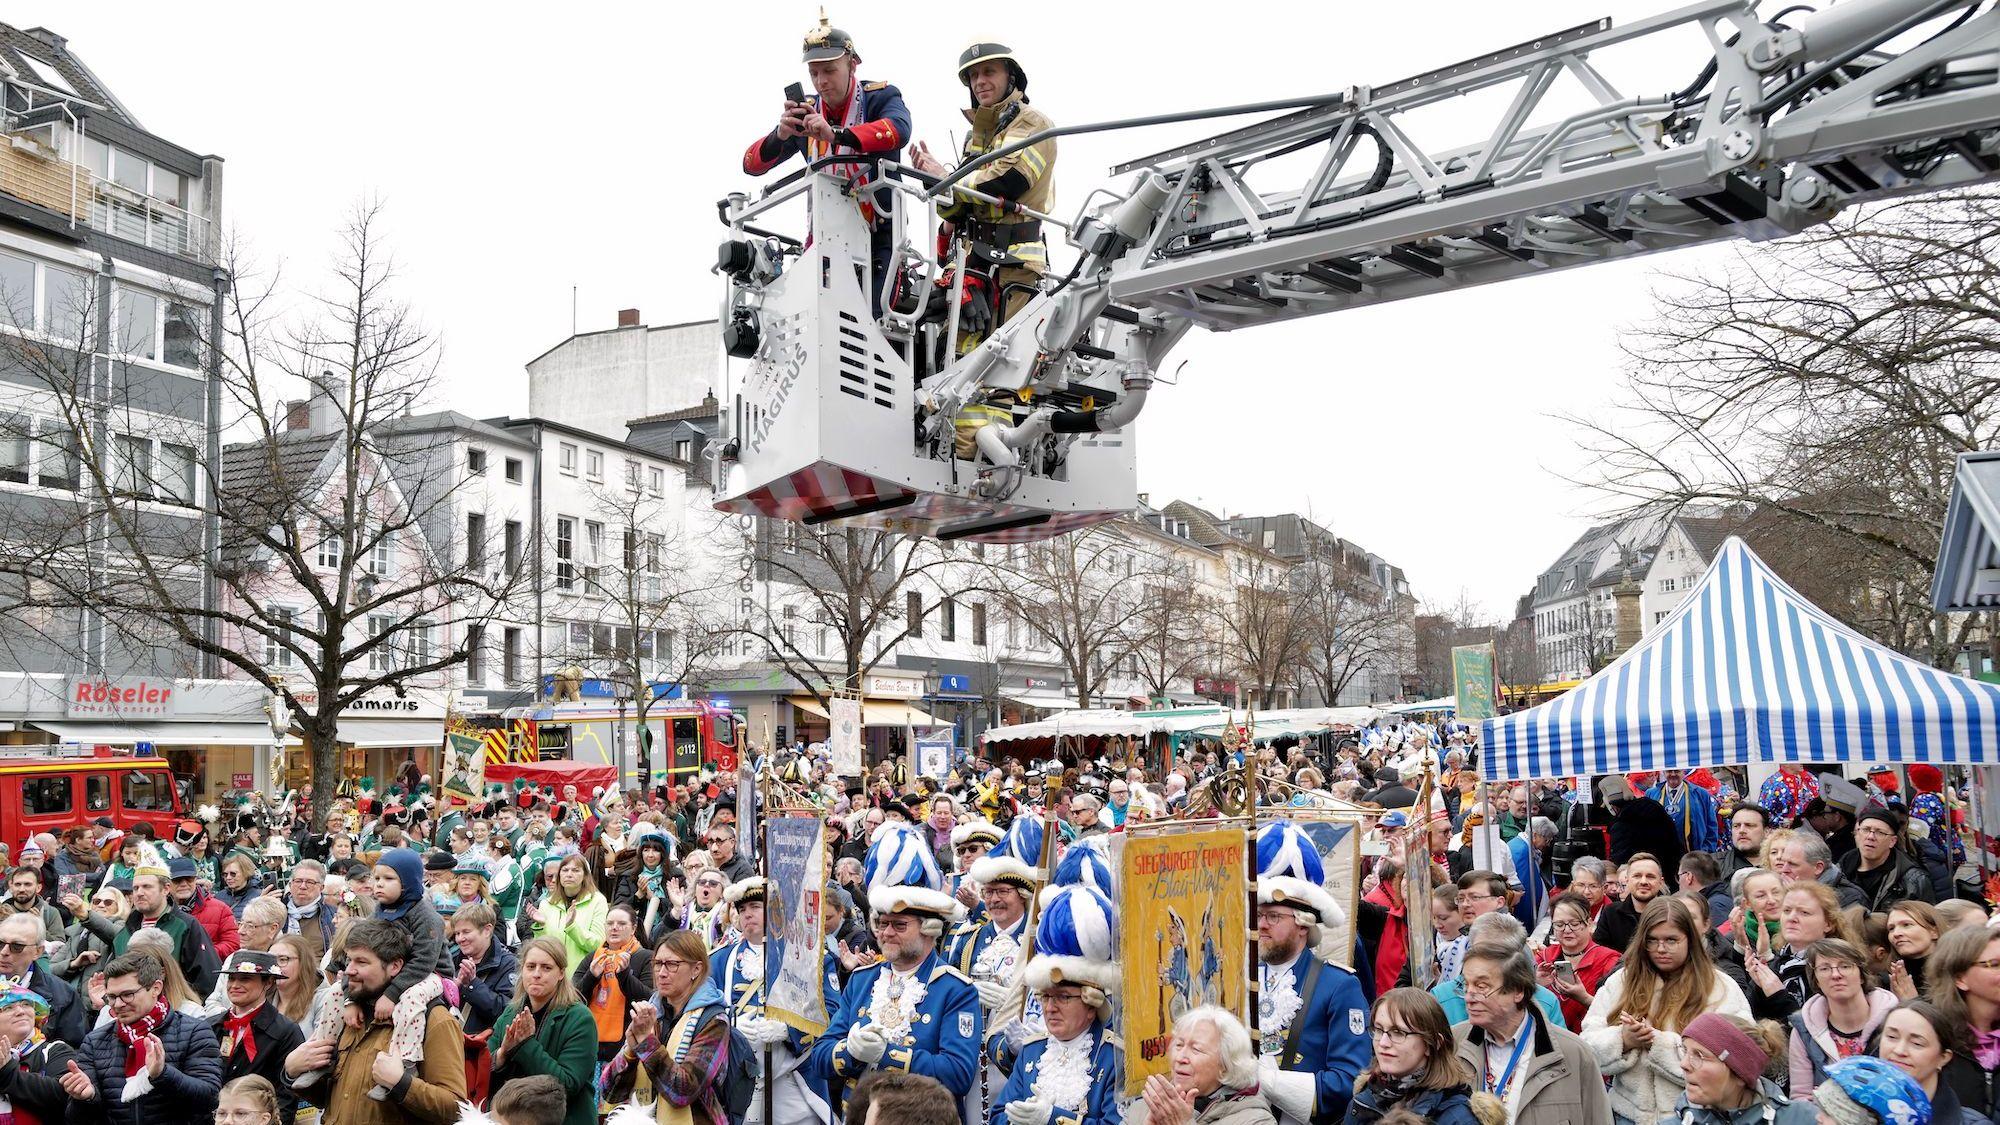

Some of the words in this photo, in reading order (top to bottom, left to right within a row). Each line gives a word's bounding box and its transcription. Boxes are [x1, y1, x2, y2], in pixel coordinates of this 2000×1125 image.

[751, 344, 808, 455] MAGIRUS
[76, 681, 171, 704] Röseler
[457, 700, 483, 708] Tamaris
[683, 743, 696, 755] 112
[1134, 849, 1199, 876] SIEGBURGER
[1202, 845, 1242, 867] FUNKEN
[1140, 1035, 1166, 1061] 1859
